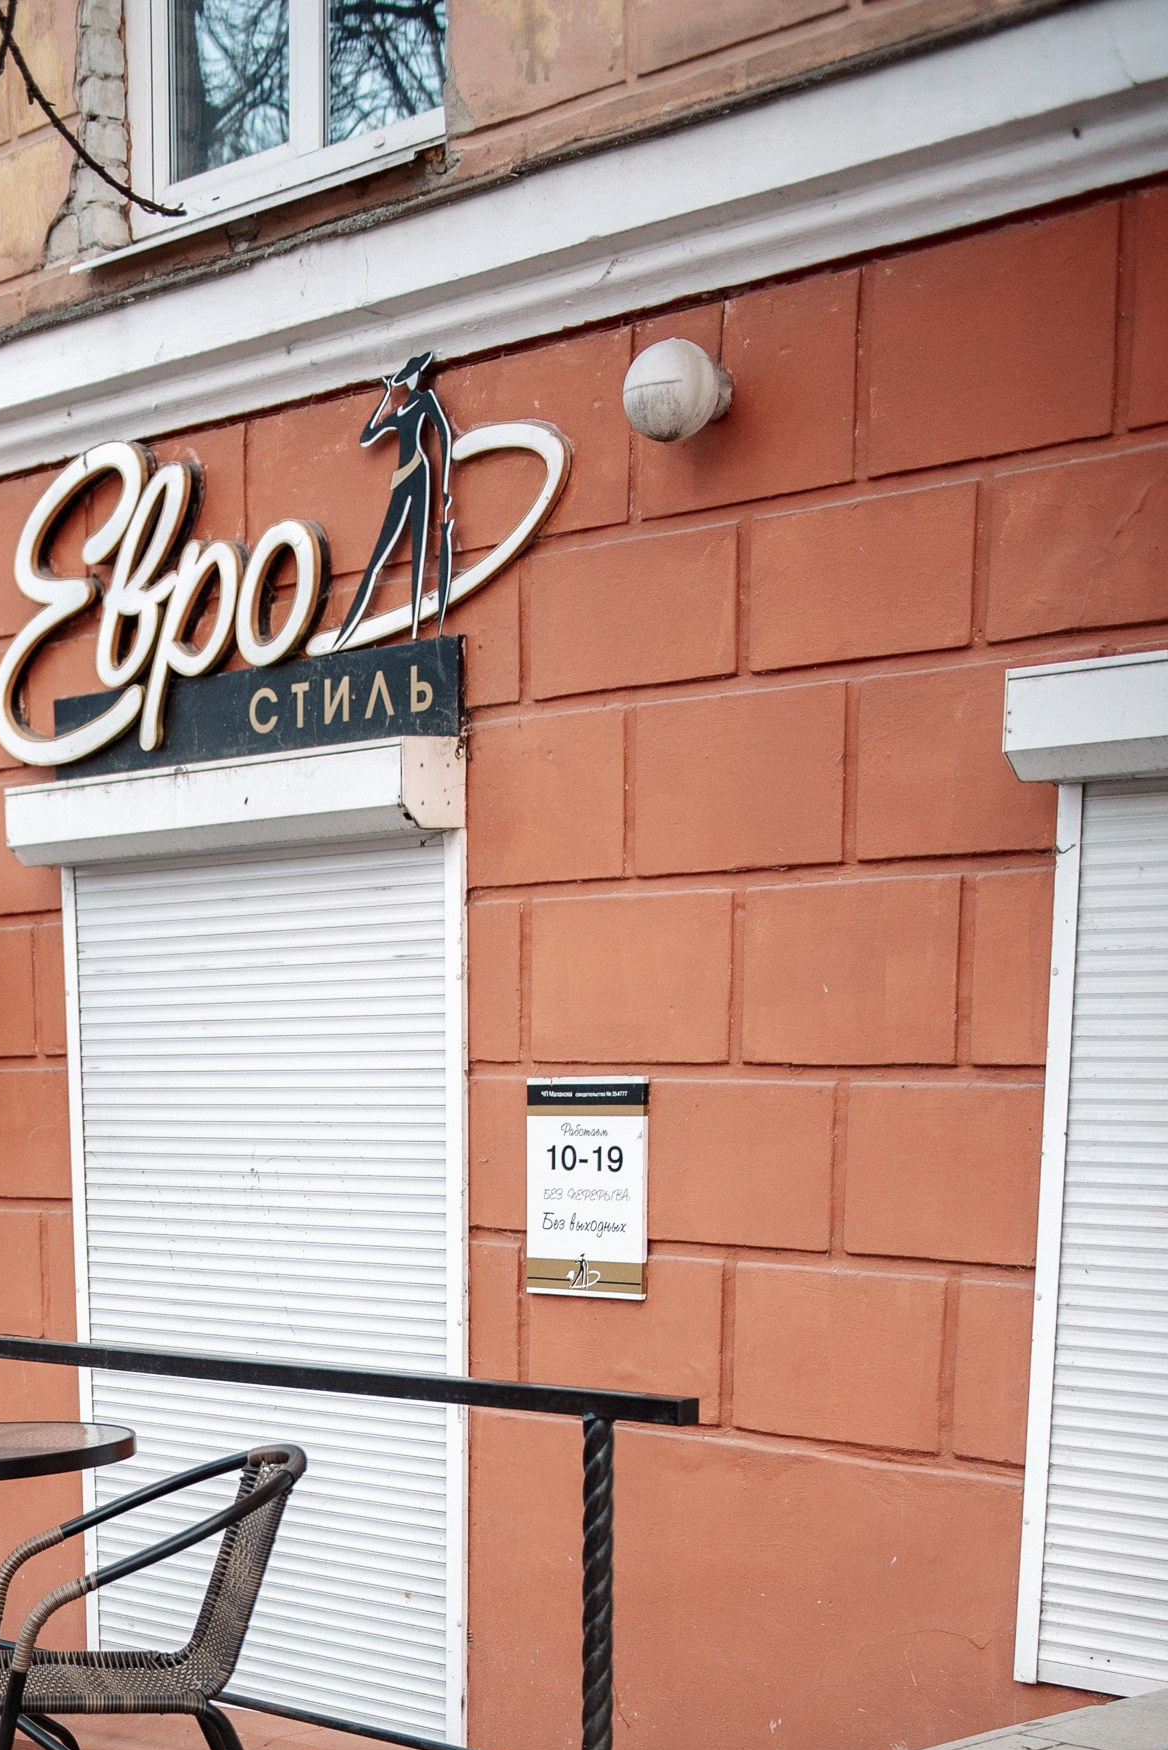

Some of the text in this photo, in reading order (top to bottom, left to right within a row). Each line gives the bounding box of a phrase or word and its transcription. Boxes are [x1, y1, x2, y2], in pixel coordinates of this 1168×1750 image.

[248, 665, 434, 735] СТИЛЬ
[560, 1122, 609, 1137] Работаем
[546, 1144, 624, 1173] 10-19
[543, 1187, 563, 1200] БЕЗ
[542, 1211, 627, 1238] Без выходных
